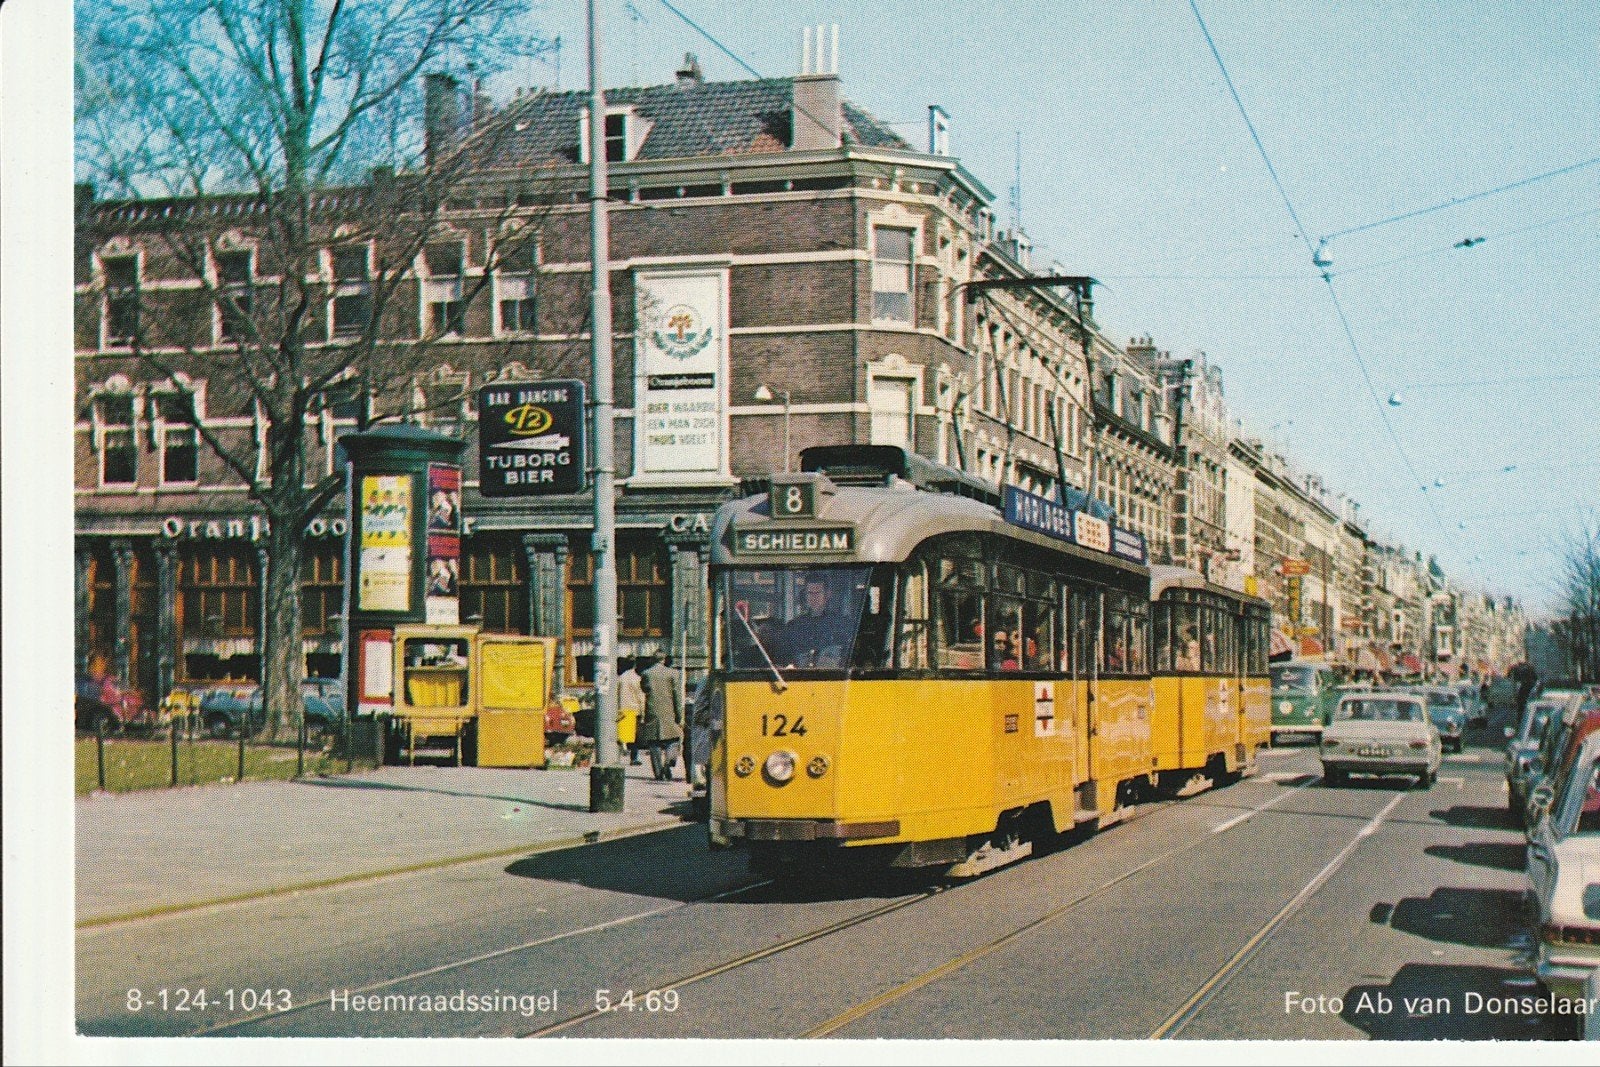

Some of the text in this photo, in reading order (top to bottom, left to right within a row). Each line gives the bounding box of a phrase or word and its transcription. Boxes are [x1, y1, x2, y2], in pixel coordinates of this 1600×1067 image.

[488, 388, 569, 406] BAR DANCING
[647, 402, 670, 414] BIER
[647, 419, 666, 430] EEN
[668, 418, 691, 429] MAN
[486, 451, 571, 469] TUBORG
[505, 469, 555, 485] BIER
[786, 485, 803, 513] 8
[671, 512, 712, 531] CA
[744, 532, 849, 550] SCHIEDAM
[761, 712, 808, 737] 124
